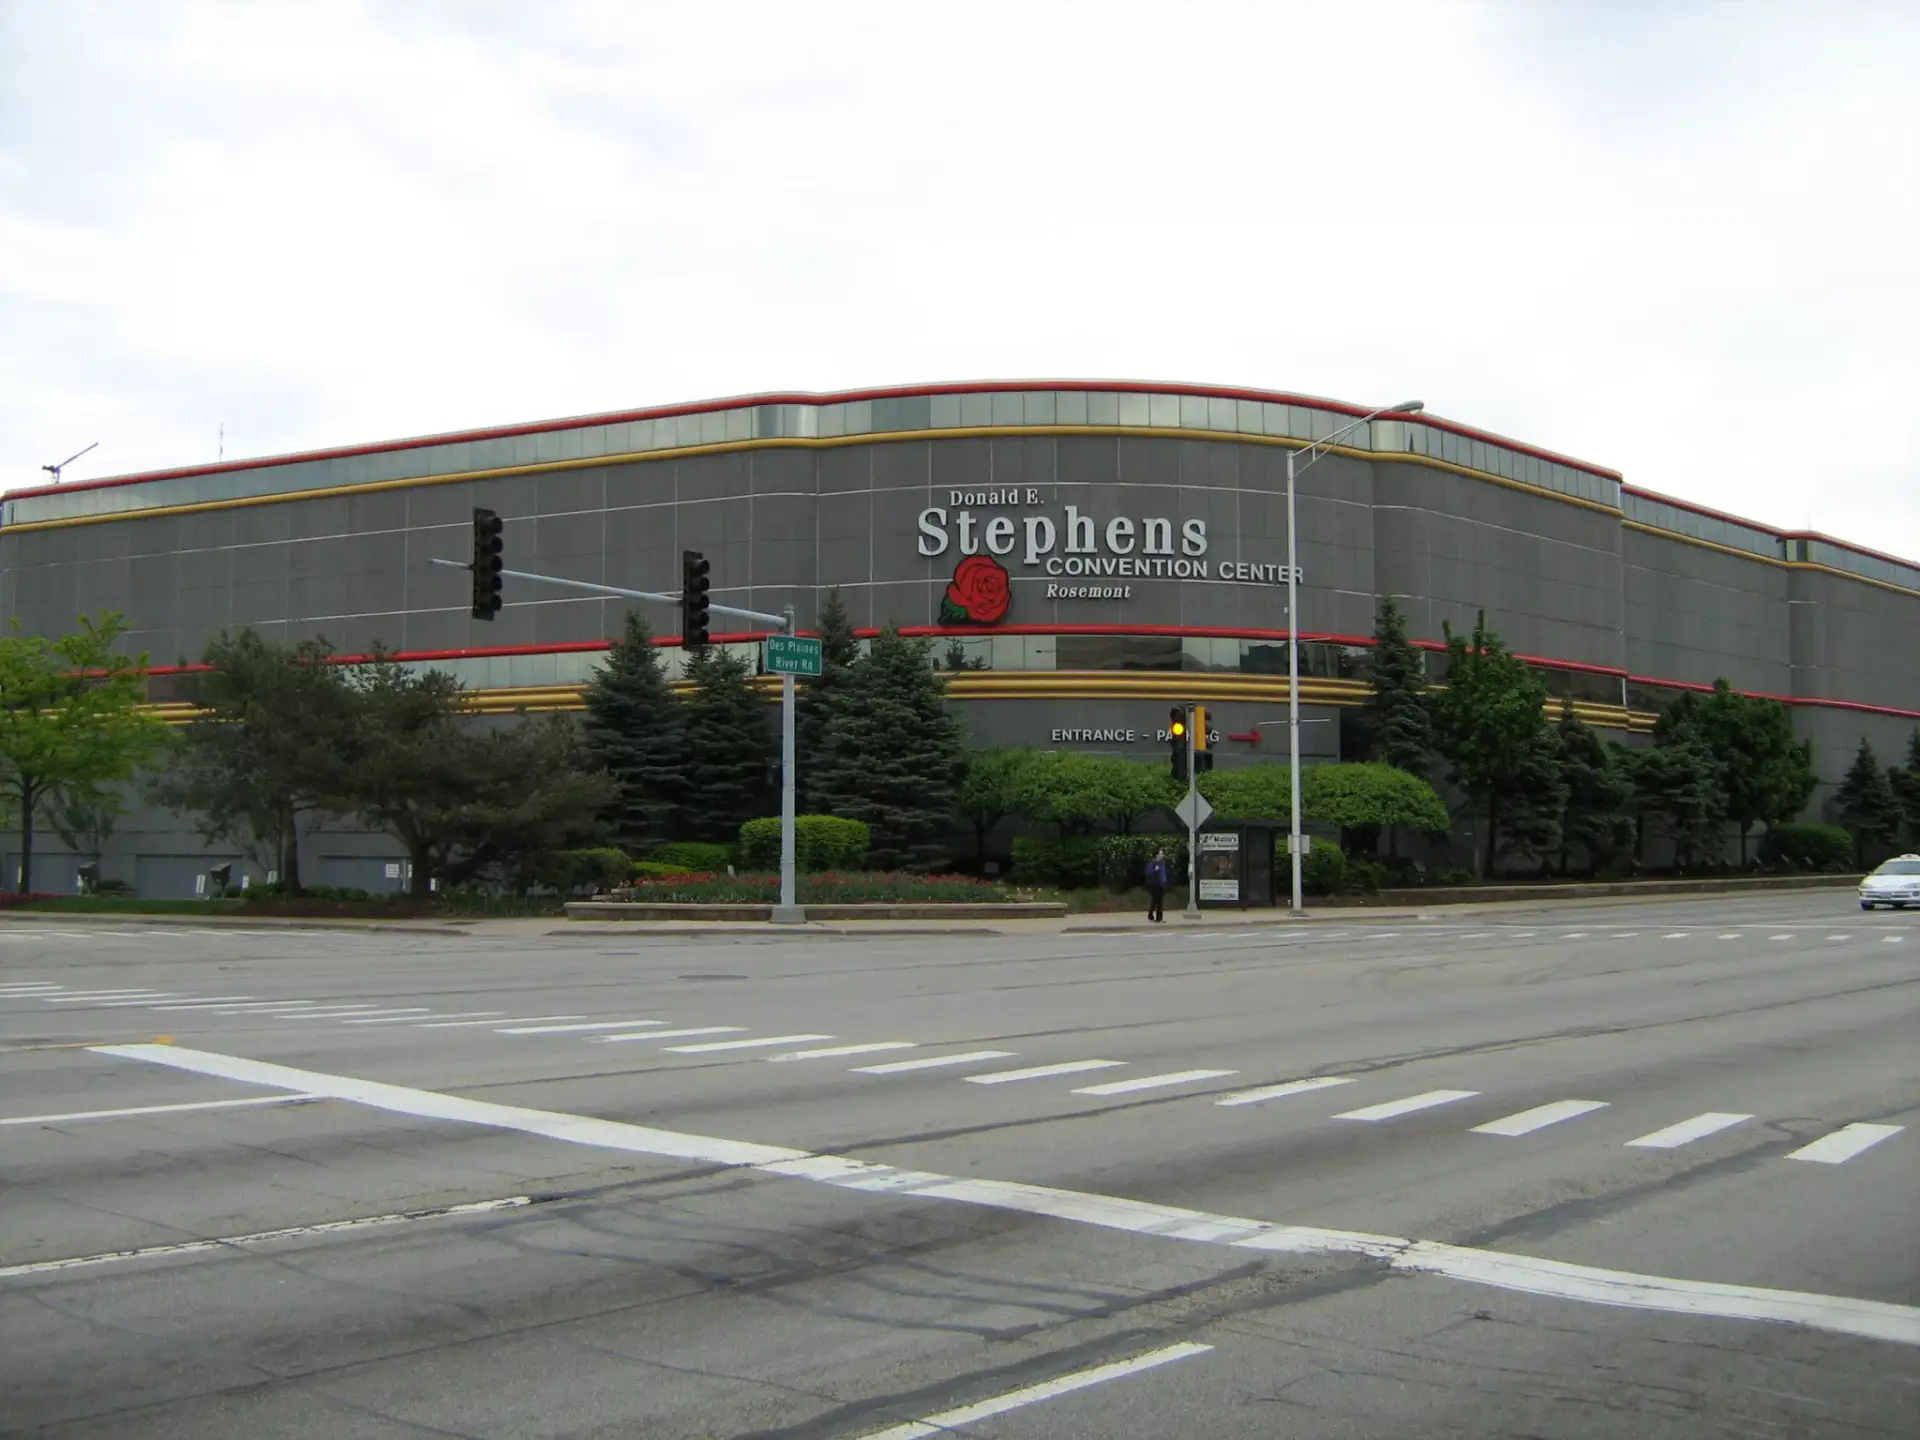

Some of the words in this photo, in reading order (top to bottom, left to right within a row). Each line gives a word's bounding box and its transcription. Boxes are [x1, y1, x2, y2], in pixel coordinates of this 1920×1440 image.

[950, 489, 1019, 506] Donald
[1026, 488, 1045, 505] E.
[918, 505, 1208, 564] Stephens
[1046, 557, 1208, 578] CONVENTION
[1219, 561, 1304, 584] CENTER
[1046, 584, 1131, 598] Rosemont
[769, 639, 785, 651] Des
[788, 640, 819, 655] Plaines
[775, 656, 798, 669] River
[802, 659, 813, 670] Rd
[1052, 729, 1135, 742] ENTRANCE
